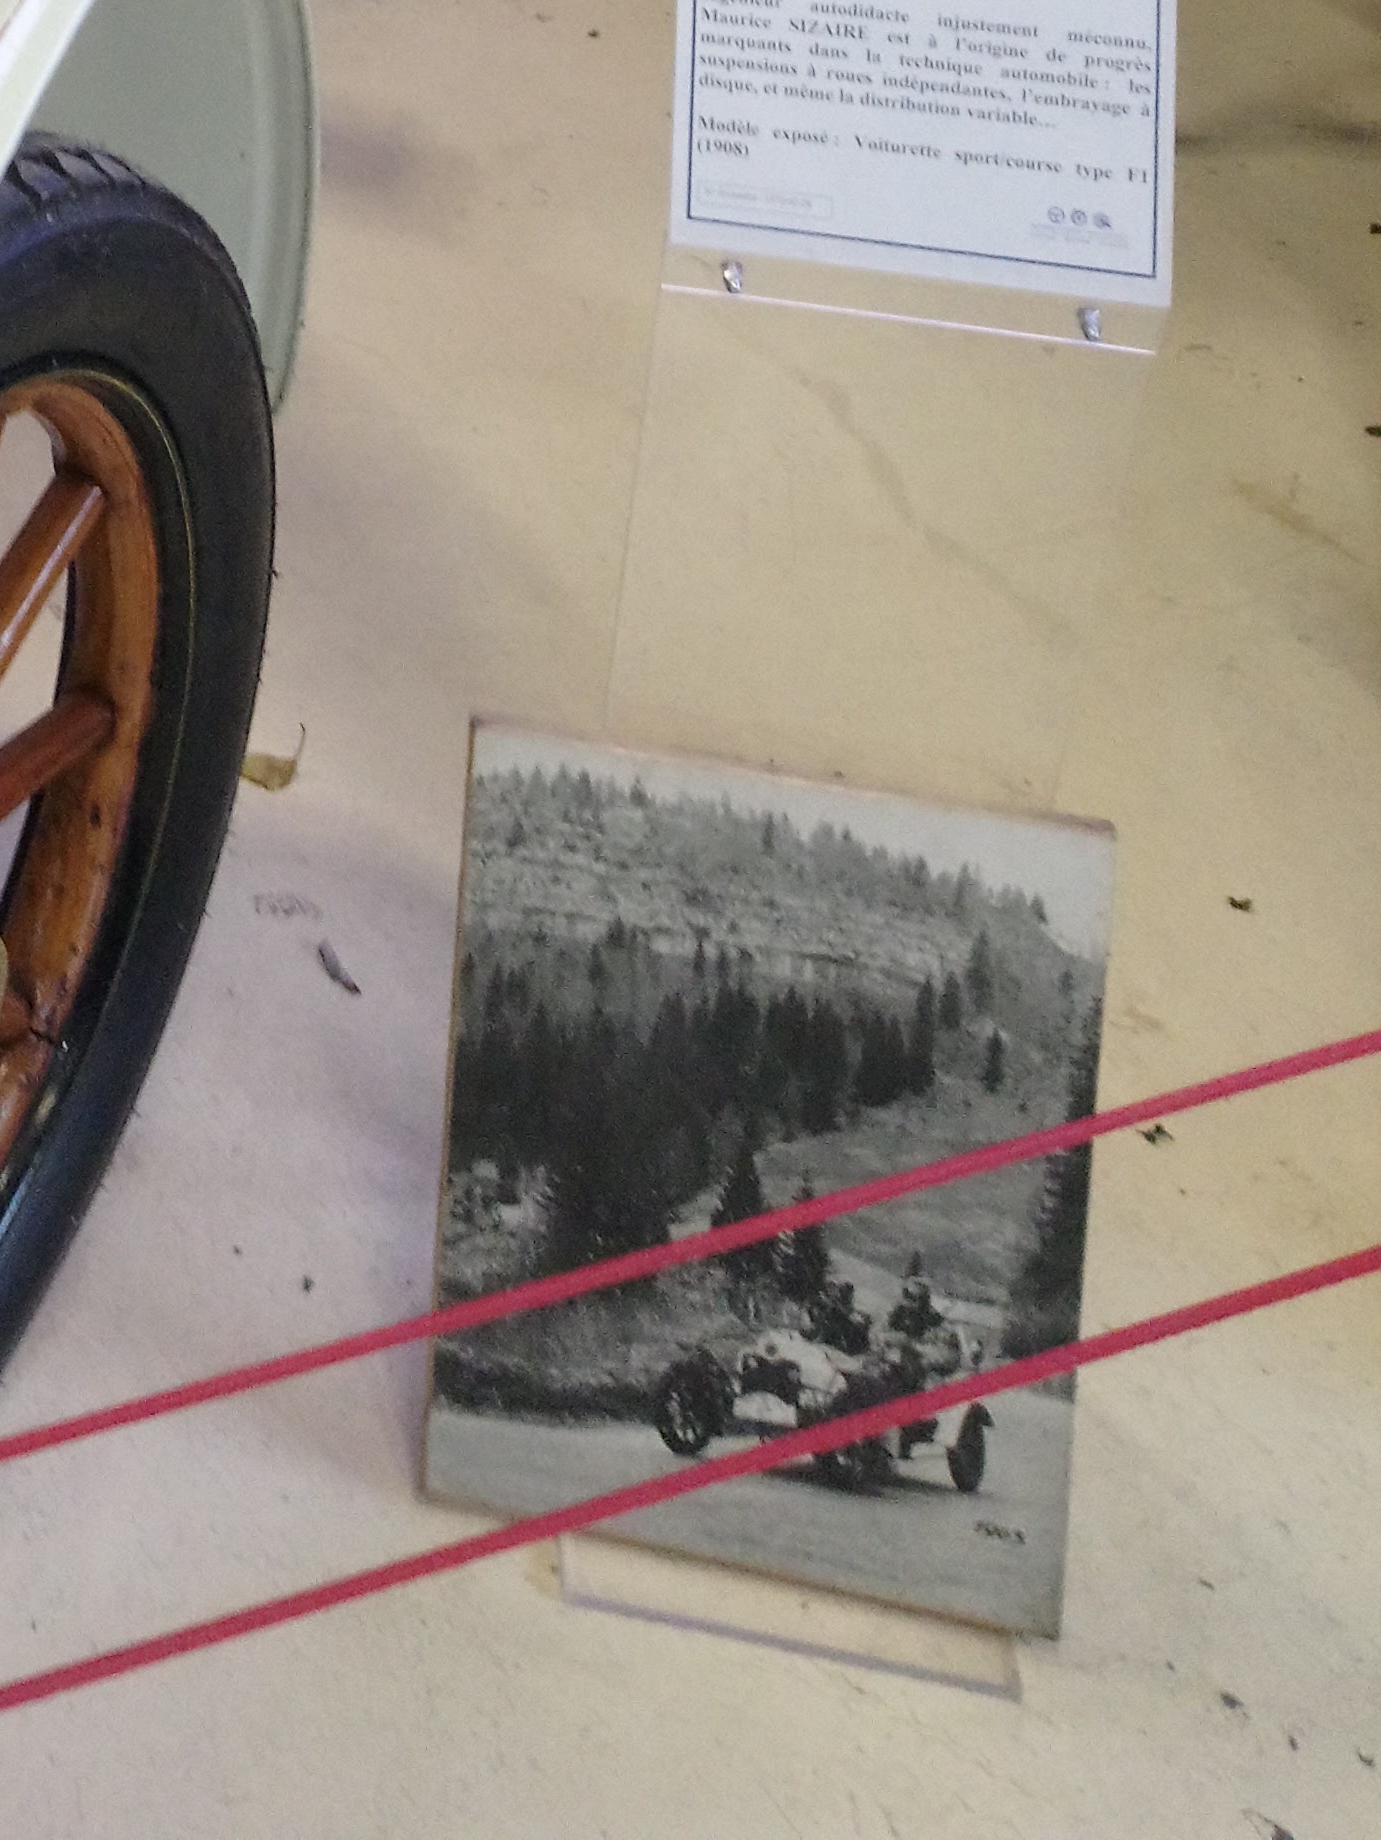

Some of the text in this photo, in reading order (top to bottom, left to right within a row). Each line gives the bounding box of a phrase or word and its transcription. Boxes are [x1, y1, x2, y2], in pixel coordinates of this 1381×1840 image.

[700, 29, 791, 57] marquants
[808, 41, 848, 59] dans
[865, 48, 881, 63] la
[898, 51, 982, 78] technique
[1129, 77, 1151, 94] les
[701, 7, 771, 29] Maurice
[788, 17, 866, 40] SIZAIRE
[886, 28, 909, 45] est
[927, 32, 937, 48] à
[1045, 45, 1066, 62] de
[1083, 50, 1151, 75] progrès
[937, 12, 1038, 41] injustement
[1066, 26, 1153, 52] méconnu,
[698, 50, 797, 80] suspensions
[806, 63, 816, 78] à
[826, 69, 873, 85] roues
[882, 71, 1012, 104] indépendantes,
[1140, 101, 1150, 116] à
[698, 72, 758, 97] disque,
[762, 80, 778, 95] et
[782, 82, 833, 102] même
[838, 88, 854, 104] la
[859, 91, 960, 116] distribution
[696, 137, 749, 160] (1908)
[698, 115, 759, 137] Modèle
[853, 133, 941, 159] Voiturette
[1074, 159, 1112, 183] type
[1127, 165, 1147, 183] F1
